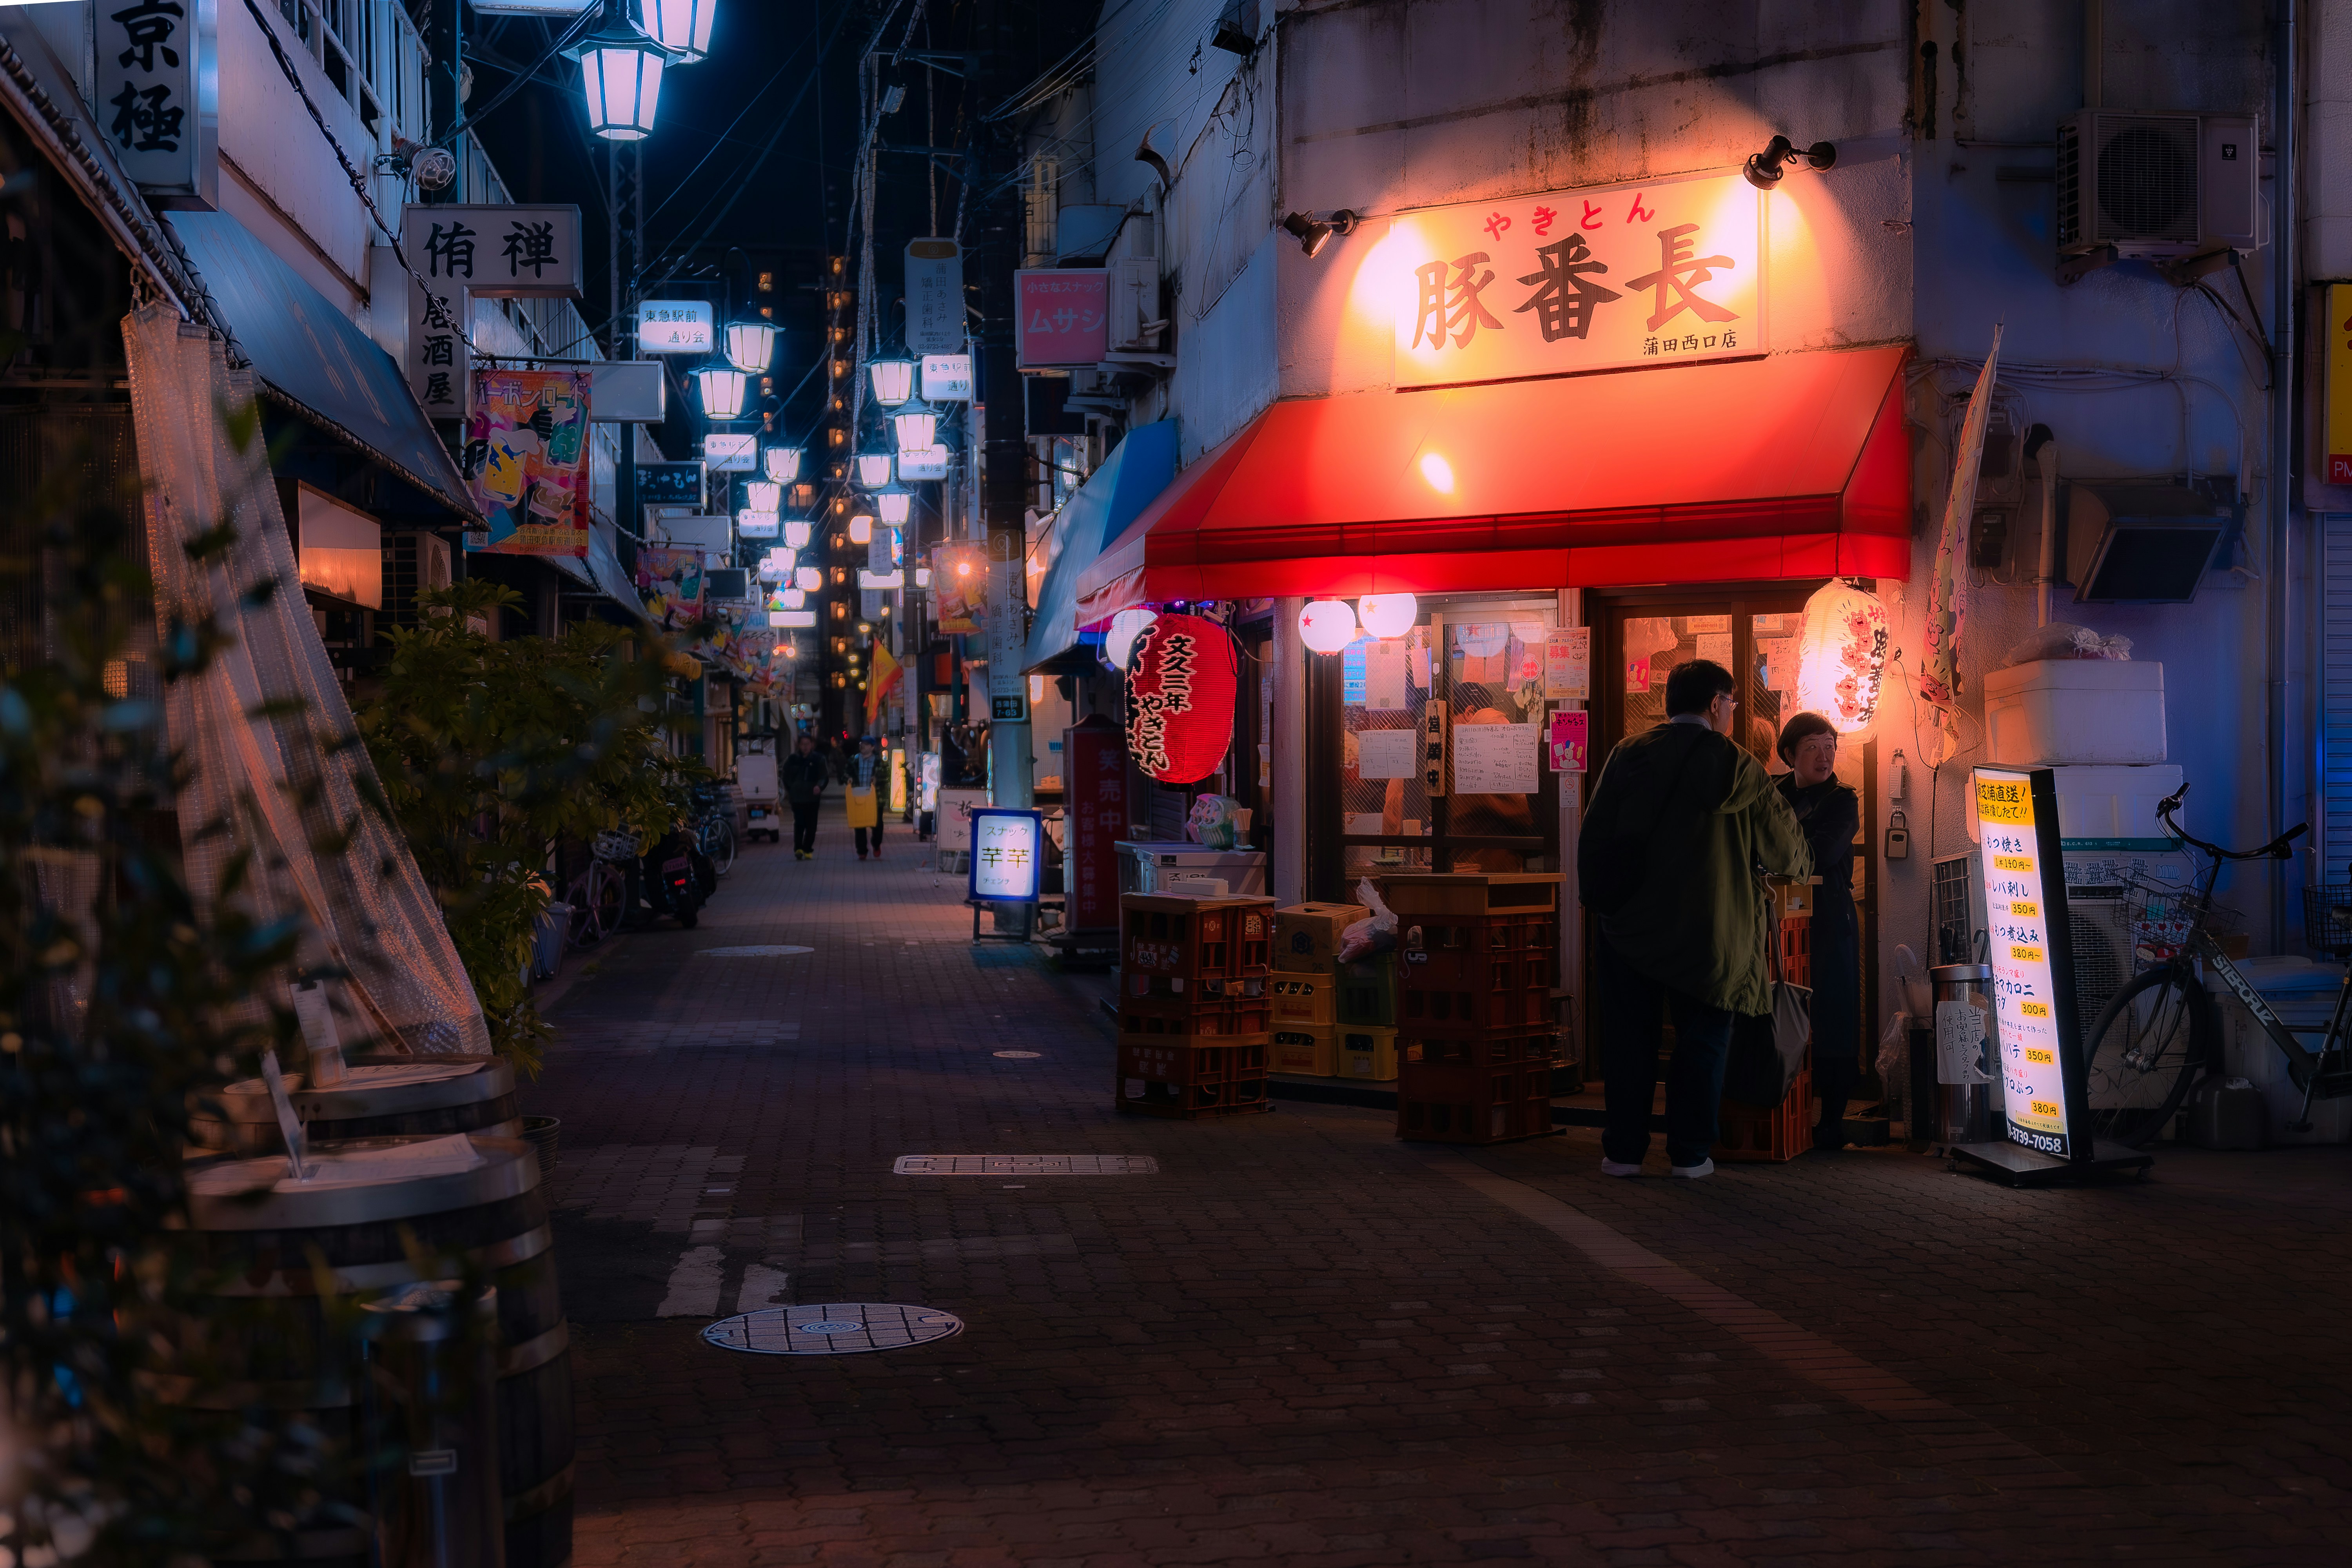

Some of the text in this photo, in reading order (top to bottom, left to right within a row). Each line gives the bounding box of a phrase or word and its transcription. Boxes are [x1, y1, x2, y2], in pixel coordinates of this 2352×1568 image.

[111, 0, 185, 152] 京極
[1483, 192, 1655, 241] やきとん
[423, 221, 559, 279] 侑禅
[936, 263, 947, 322] 蒲田あさみ
[1027, 281, 1103, 293] 小さなスナック
[1412, 223, 1741, 350] 豚番長
[645, 310, 697, 323] 東急駅前
[1028, 308, 1104, 333] ムサシ
[668, 330, 704, 344] 通り会
[1642, 329, 1737, 356] 蒲田西口店
[421, 296, 454, 405] 居酒屋
[476, 379, 587, 407] バーボンロード
[1549, 645, 1570, 659] 募集
[1775, 645, 1790, 654] おで
[1157, 633, 1198, 714] 文久三年
[997, 709, 1017, 717] 7-63
[1138, 692, 1170, 771] やきとん
[1427, 715, 1443, 788] 営業中
[1098, 748, 1121, 833] 笑売中
[987, 826, 1028, 837] スナック
[1987, 834, 2023, 853] もつ焼き
[1992, 879, 2029, 898] レバ刺し
[2013, 904, 2036, 915] 350円
[1995, 922, 2039, 944] もつ煮込み
[1996, 994, 2007, 1010] ラダ
[2022, 1004, 2046, 1016] 300円
[1942, 1014, 1956, 1054] 使用可
[1968, 1005, 1982, 1051] 当店の
[2027, 1050, 2051, 1063] 350円
[2033, 1102, 2056, 1116] 380円
